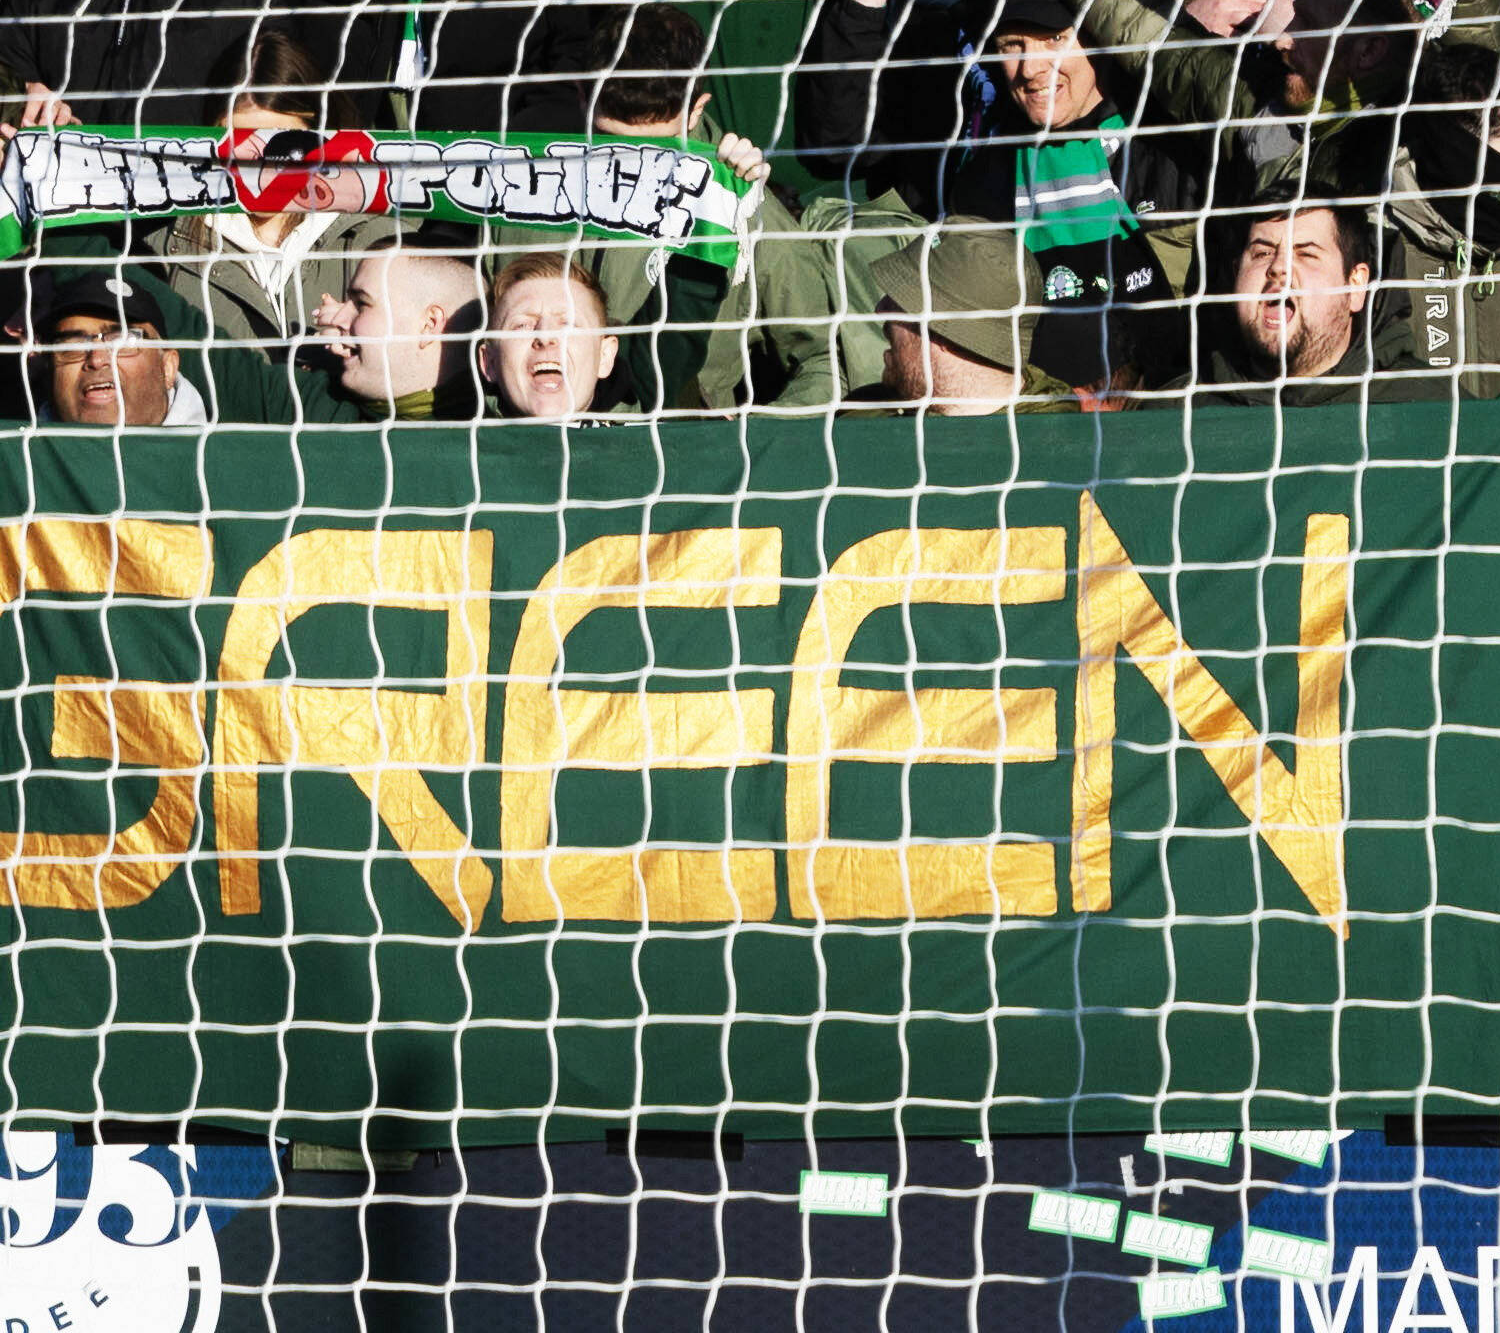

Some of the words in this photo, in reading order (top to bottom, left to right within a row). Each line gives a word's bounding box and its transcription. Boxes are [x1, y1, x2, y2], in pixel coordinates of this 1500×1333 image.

[372, 139, 713, 247] POLICE
[0, 490, 1351, 941] GREEN
[803, 1174, 887, 1214] ULTRAS
[1031, 1192, 1120, 1240] ULTRAS
[1123, 1213, 1213, 1266] ULTRAS
[1247, 1230, 1329, 1278] ULTRAS
[1140, 1270, 1223, 1316] ULTRAS
